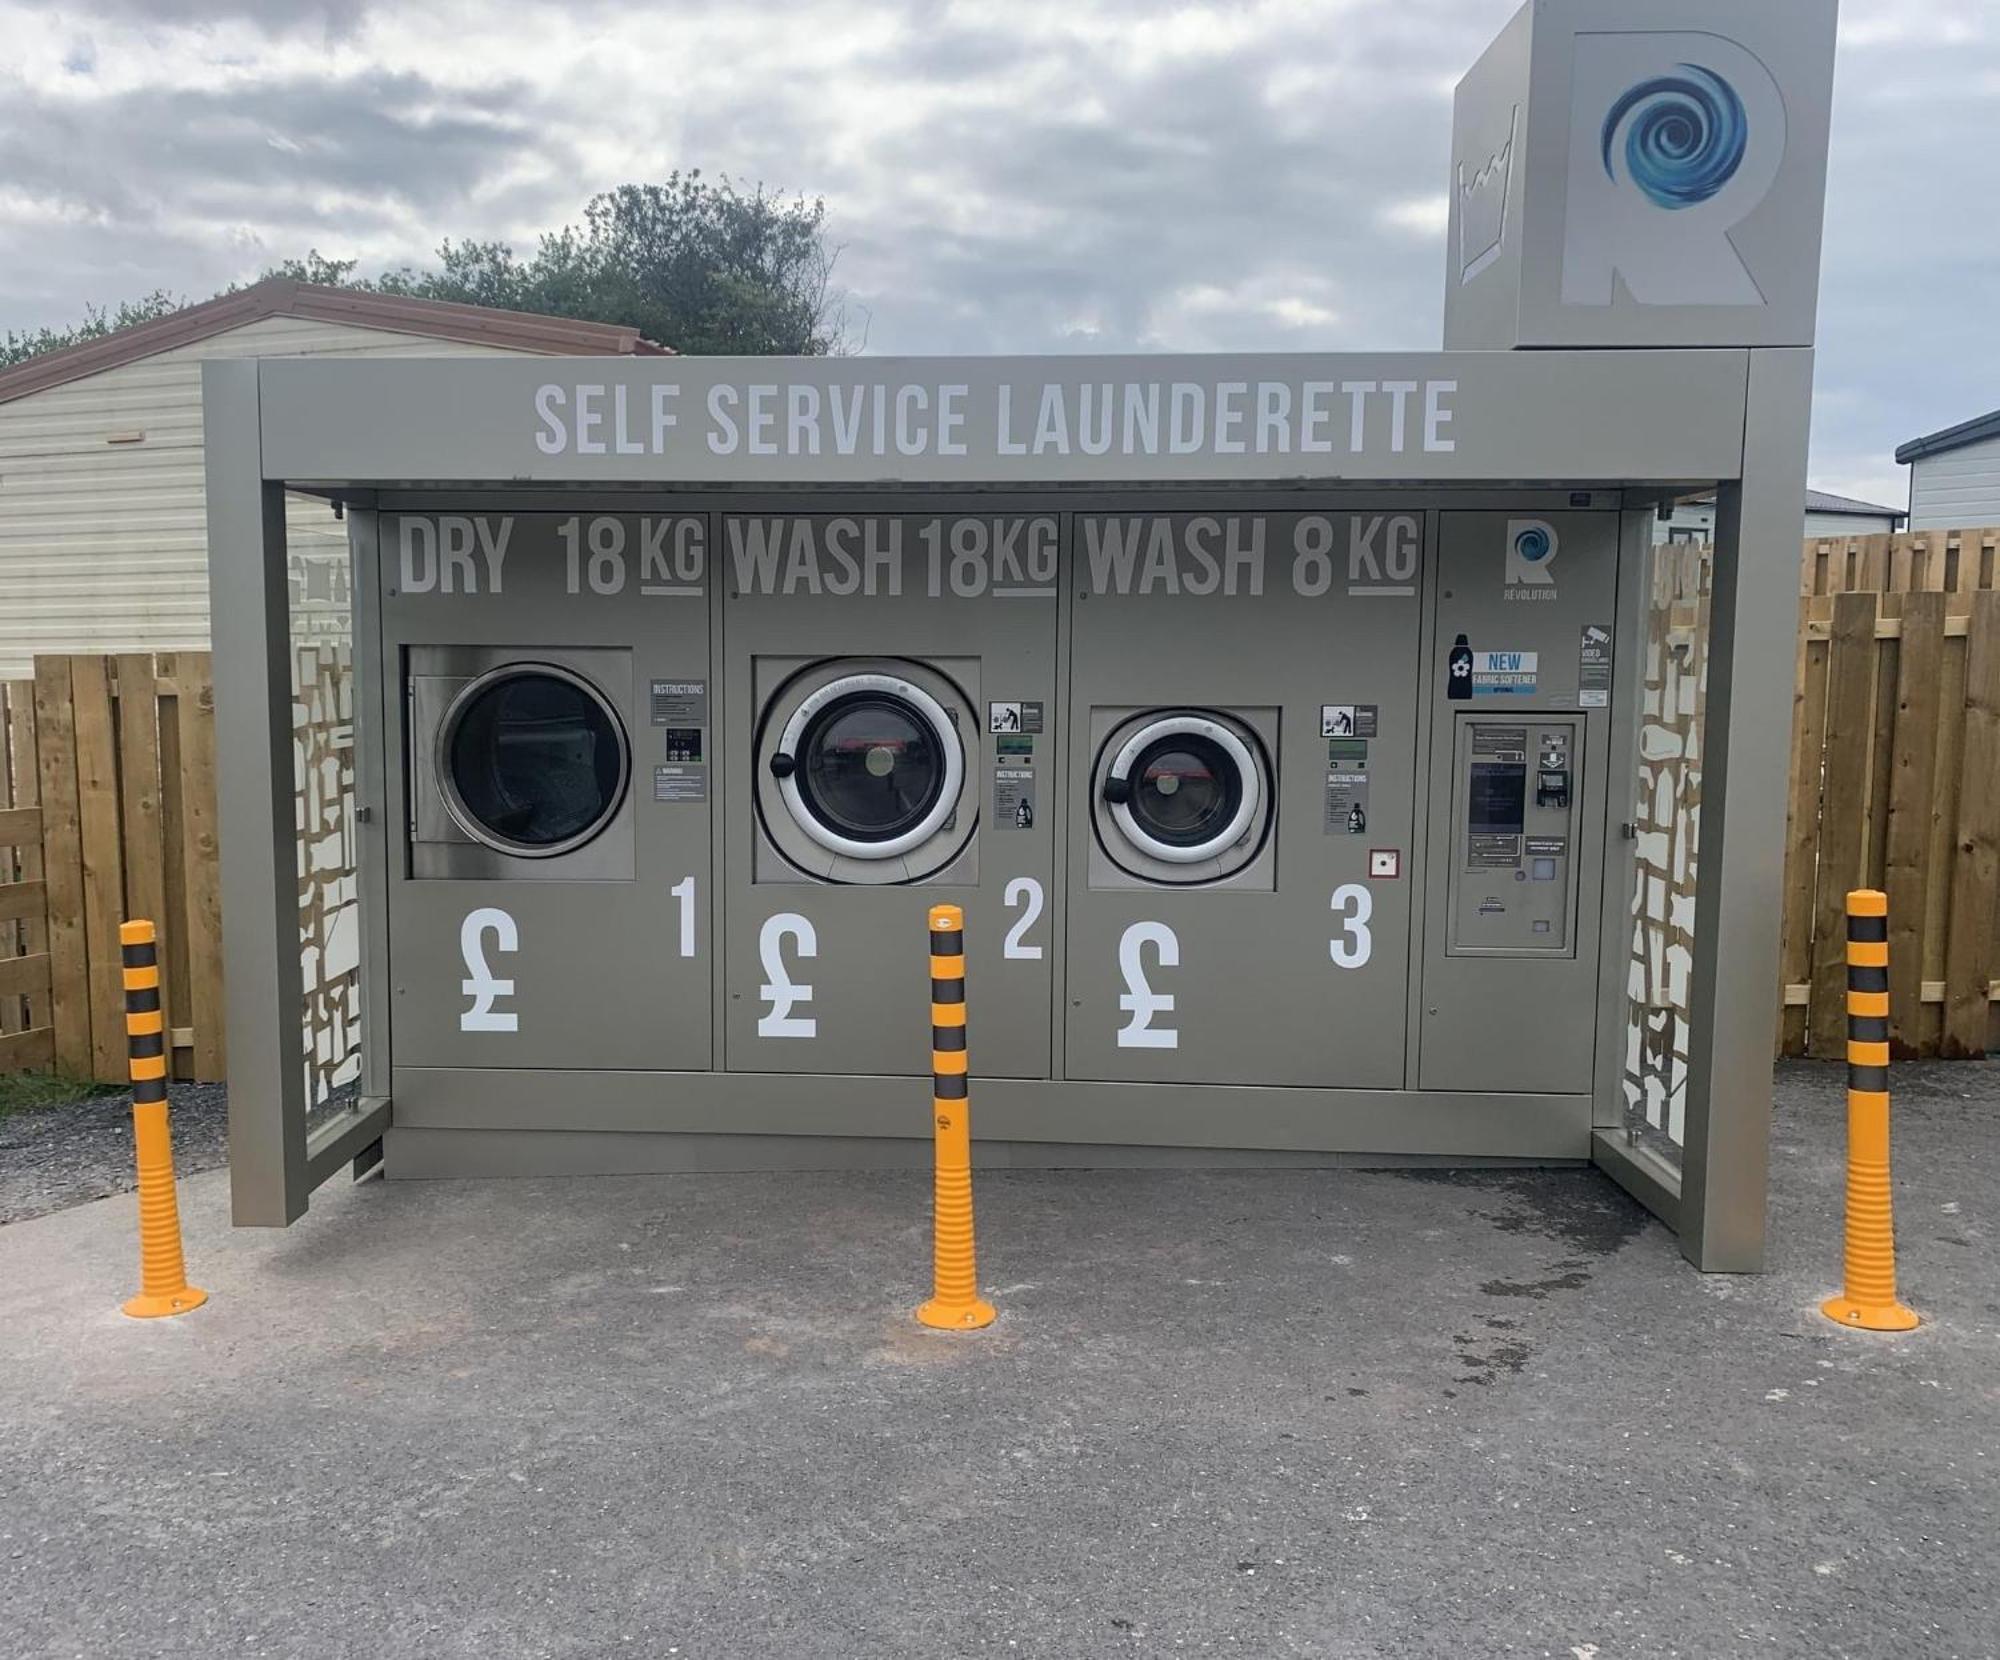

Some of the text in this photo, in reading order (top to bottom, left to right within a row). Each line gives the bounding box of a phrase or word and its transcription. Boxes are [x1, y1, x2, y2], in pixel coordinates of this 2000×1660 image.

[1560, 30, 1787, 306] R
[535, 380, 1457, 456] SELF SERVICE LAUNDERETTE
[399, 516, 704, 596] DRY 18 KG
[727, 518, 903, 596] WASH
[1084, 516, 1418, 596] WASH 8 KG
[653, 684, 704, 694] INSTRUCTIONS
[1488, 653, 1521, 671] NEW
[670, 877, 695, 958] 1
[1003, 876, 1043, 960] 2
[1330, 883, 1372, 968] 3
[459, 907, 519, 1033] £
[758, 912, 818, 1038] £
[1117, 921, 1181, 1049] £
